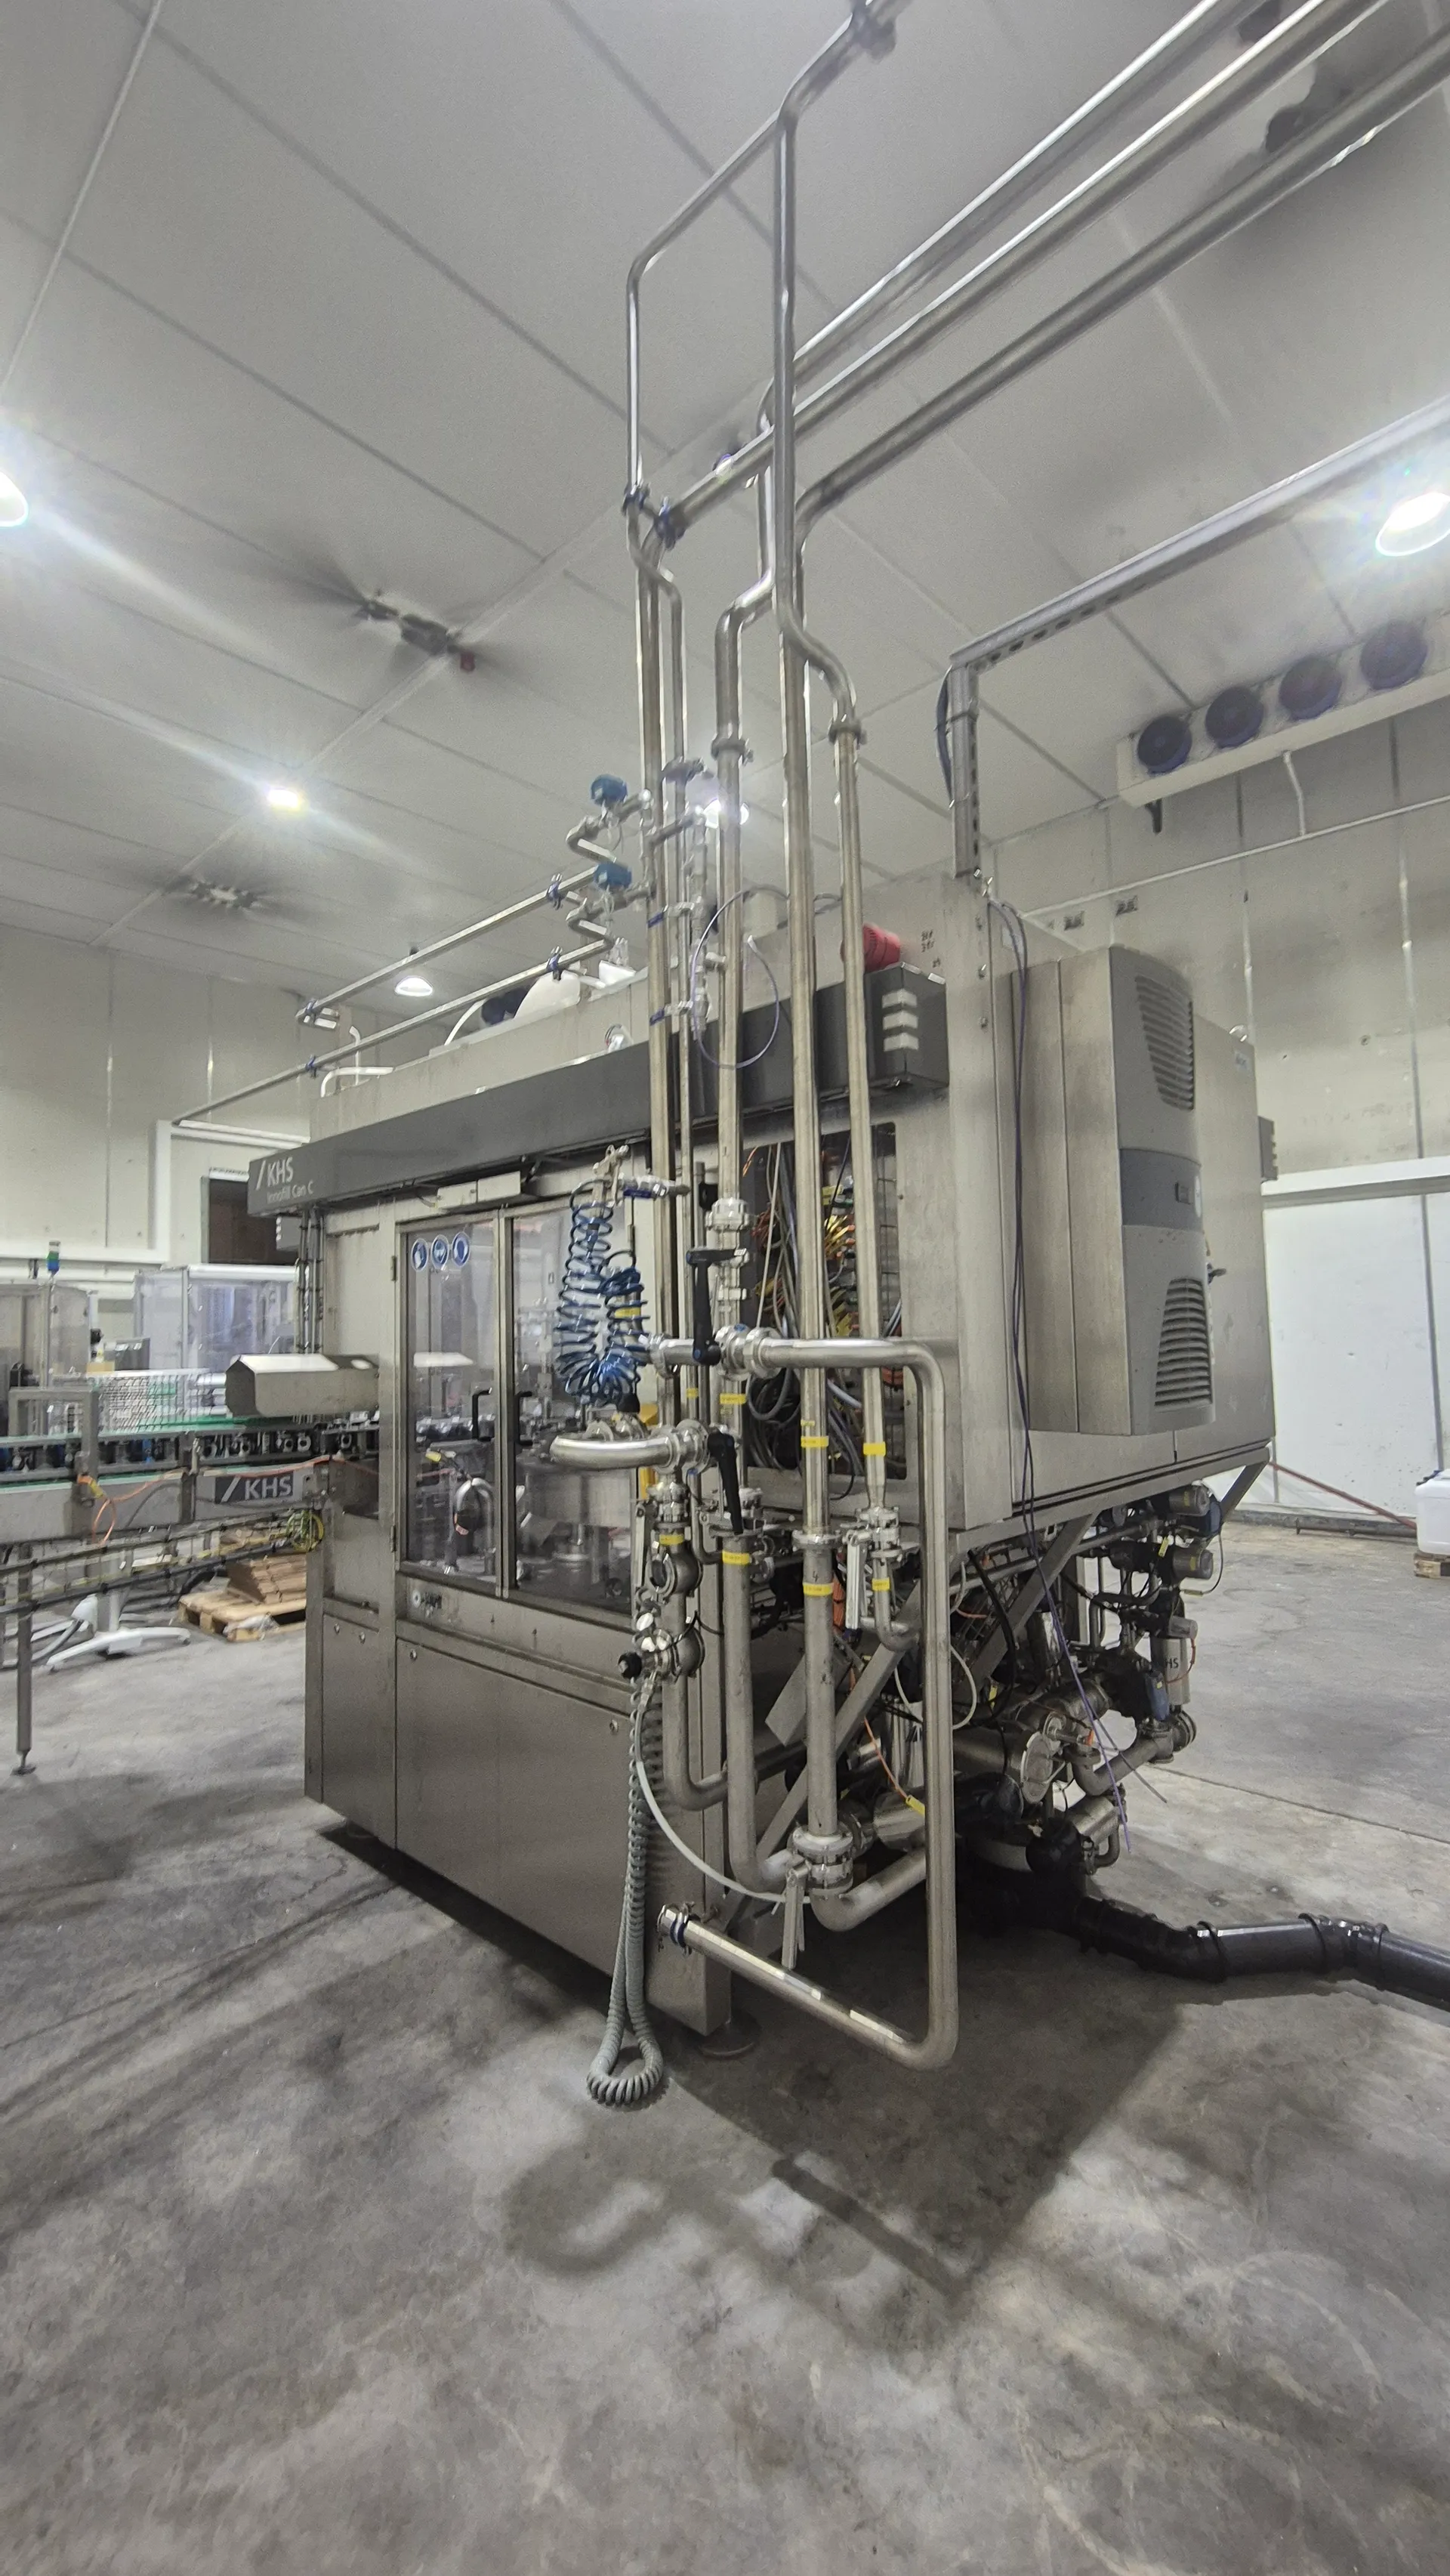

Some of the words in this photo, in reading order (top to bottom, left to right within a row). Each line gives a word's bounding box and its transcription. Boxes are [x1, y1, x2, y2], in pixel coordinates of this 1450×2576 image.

[267, 1157, 294, 1186] KHS
[307, 1180, 314, 1194] C
[244, 1475, 292, 1500] KHS
